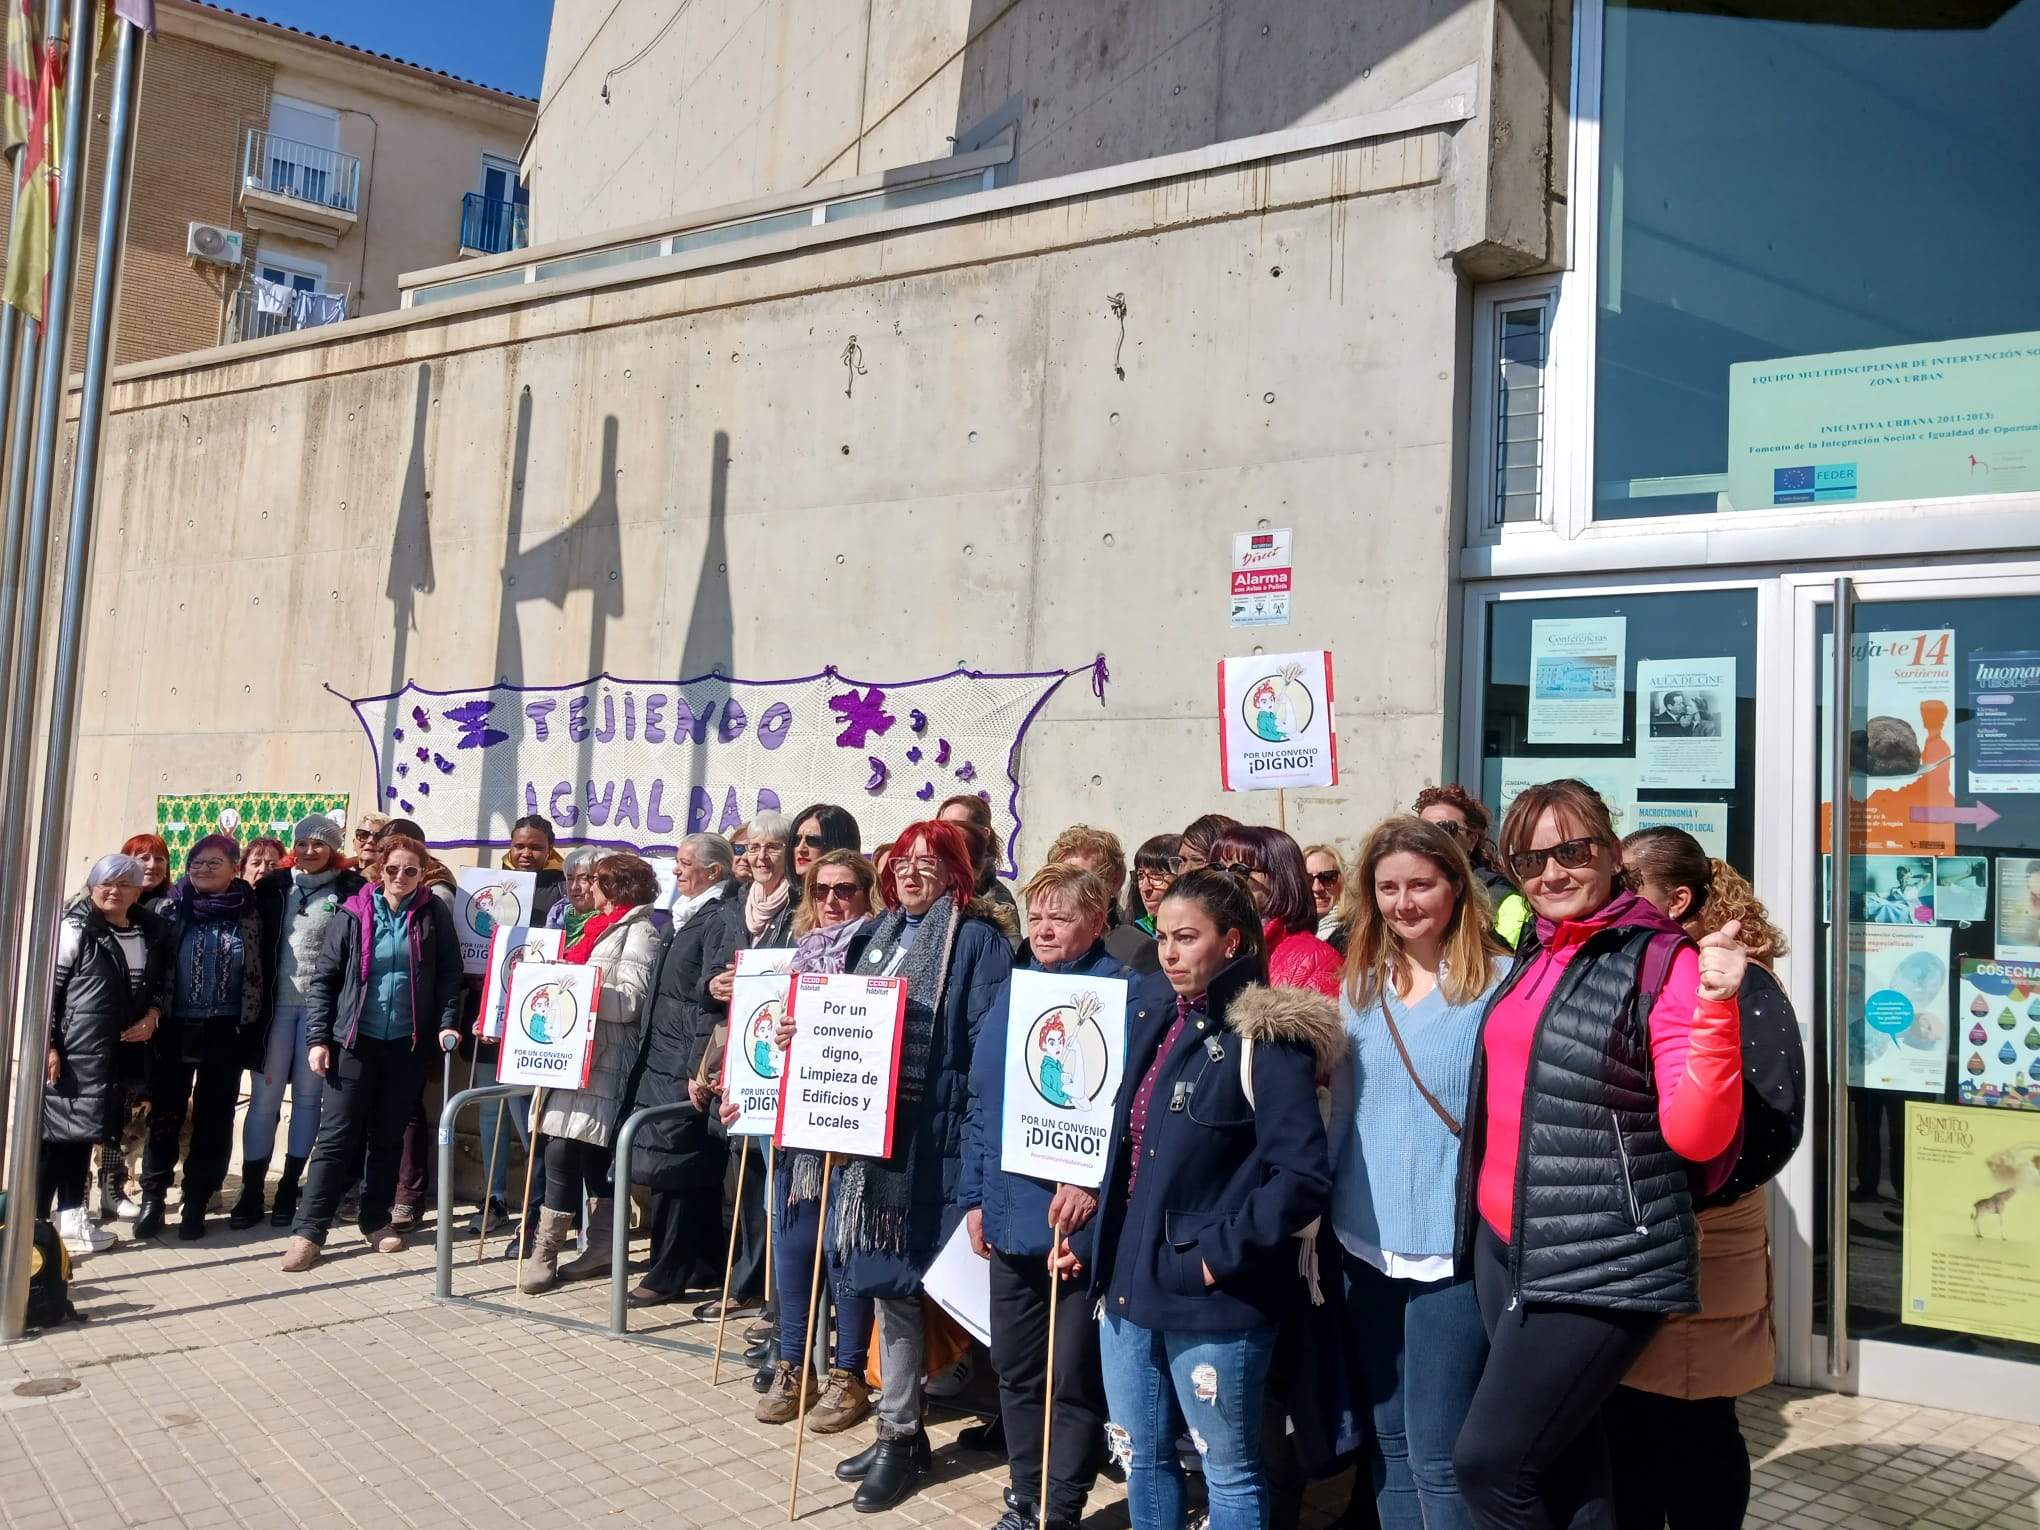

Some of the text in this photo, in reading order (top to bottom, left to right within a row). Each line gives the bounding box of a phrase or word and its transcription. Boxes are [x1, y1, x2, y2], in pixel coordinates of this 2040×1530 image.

[1752, 373, 1794, 384] EQUIPO
[1799, 361, 1908, 379] MULTIDISCIPLINAR
[1912, 360, 1927, 368] DE
[1932, 349, 2021, 366] INTERVENCIÓN
[1869, 372, 1943, 386] ZONA URBAN
[1821, 412, 1994, 433] INICIATIVA URBANA 2011-2013:
[1749, 445, 1791, 454] Fomento
[1794, 442, 1805, 450] de
[1809, 441, 1818, 449] la
[1821, 437, 1880, 449] Integración
[1883, 433, 1915, 443] Social
[1928, 428, 1975, 440] Igualdad
[1978, 427, 1990, 435] de
[1817, 469, 1855, 480] FEDER
[1235, 573, 1288, 585] Alarma
[1907, 634, 1949, 666] 14
[1650, 677, 1678, 686] AULA
[1681, 676, 1694, 685] DE
[1276, 748, 1318, 757] CONVENIO
[1249, 756, 1314, 774] ¡DIGNO!
[1695, 824, 1714, 832] LOCAL
[463, 948, 488, 960] ¡DIG
[824, 1001, 867, 1016] Por un
[813, 1025, 873, 1039] convenio
[540, 1051, 573, 1059] CONVENIO
[822, 1046, 862, 1063] digno,
[517, 1056, 567, 1070] ¡DIGNO!
[800, 1066, 878, 1085] Limpieza de
[802, 1089, 871, 1111] Edificios y
[808, 1112, 859, 1130] Locales
[1021, 1114, 1107, 1137] POR UN CONVENIO
[1026, 1127, 1100, 1156] ¡DIGNO!
